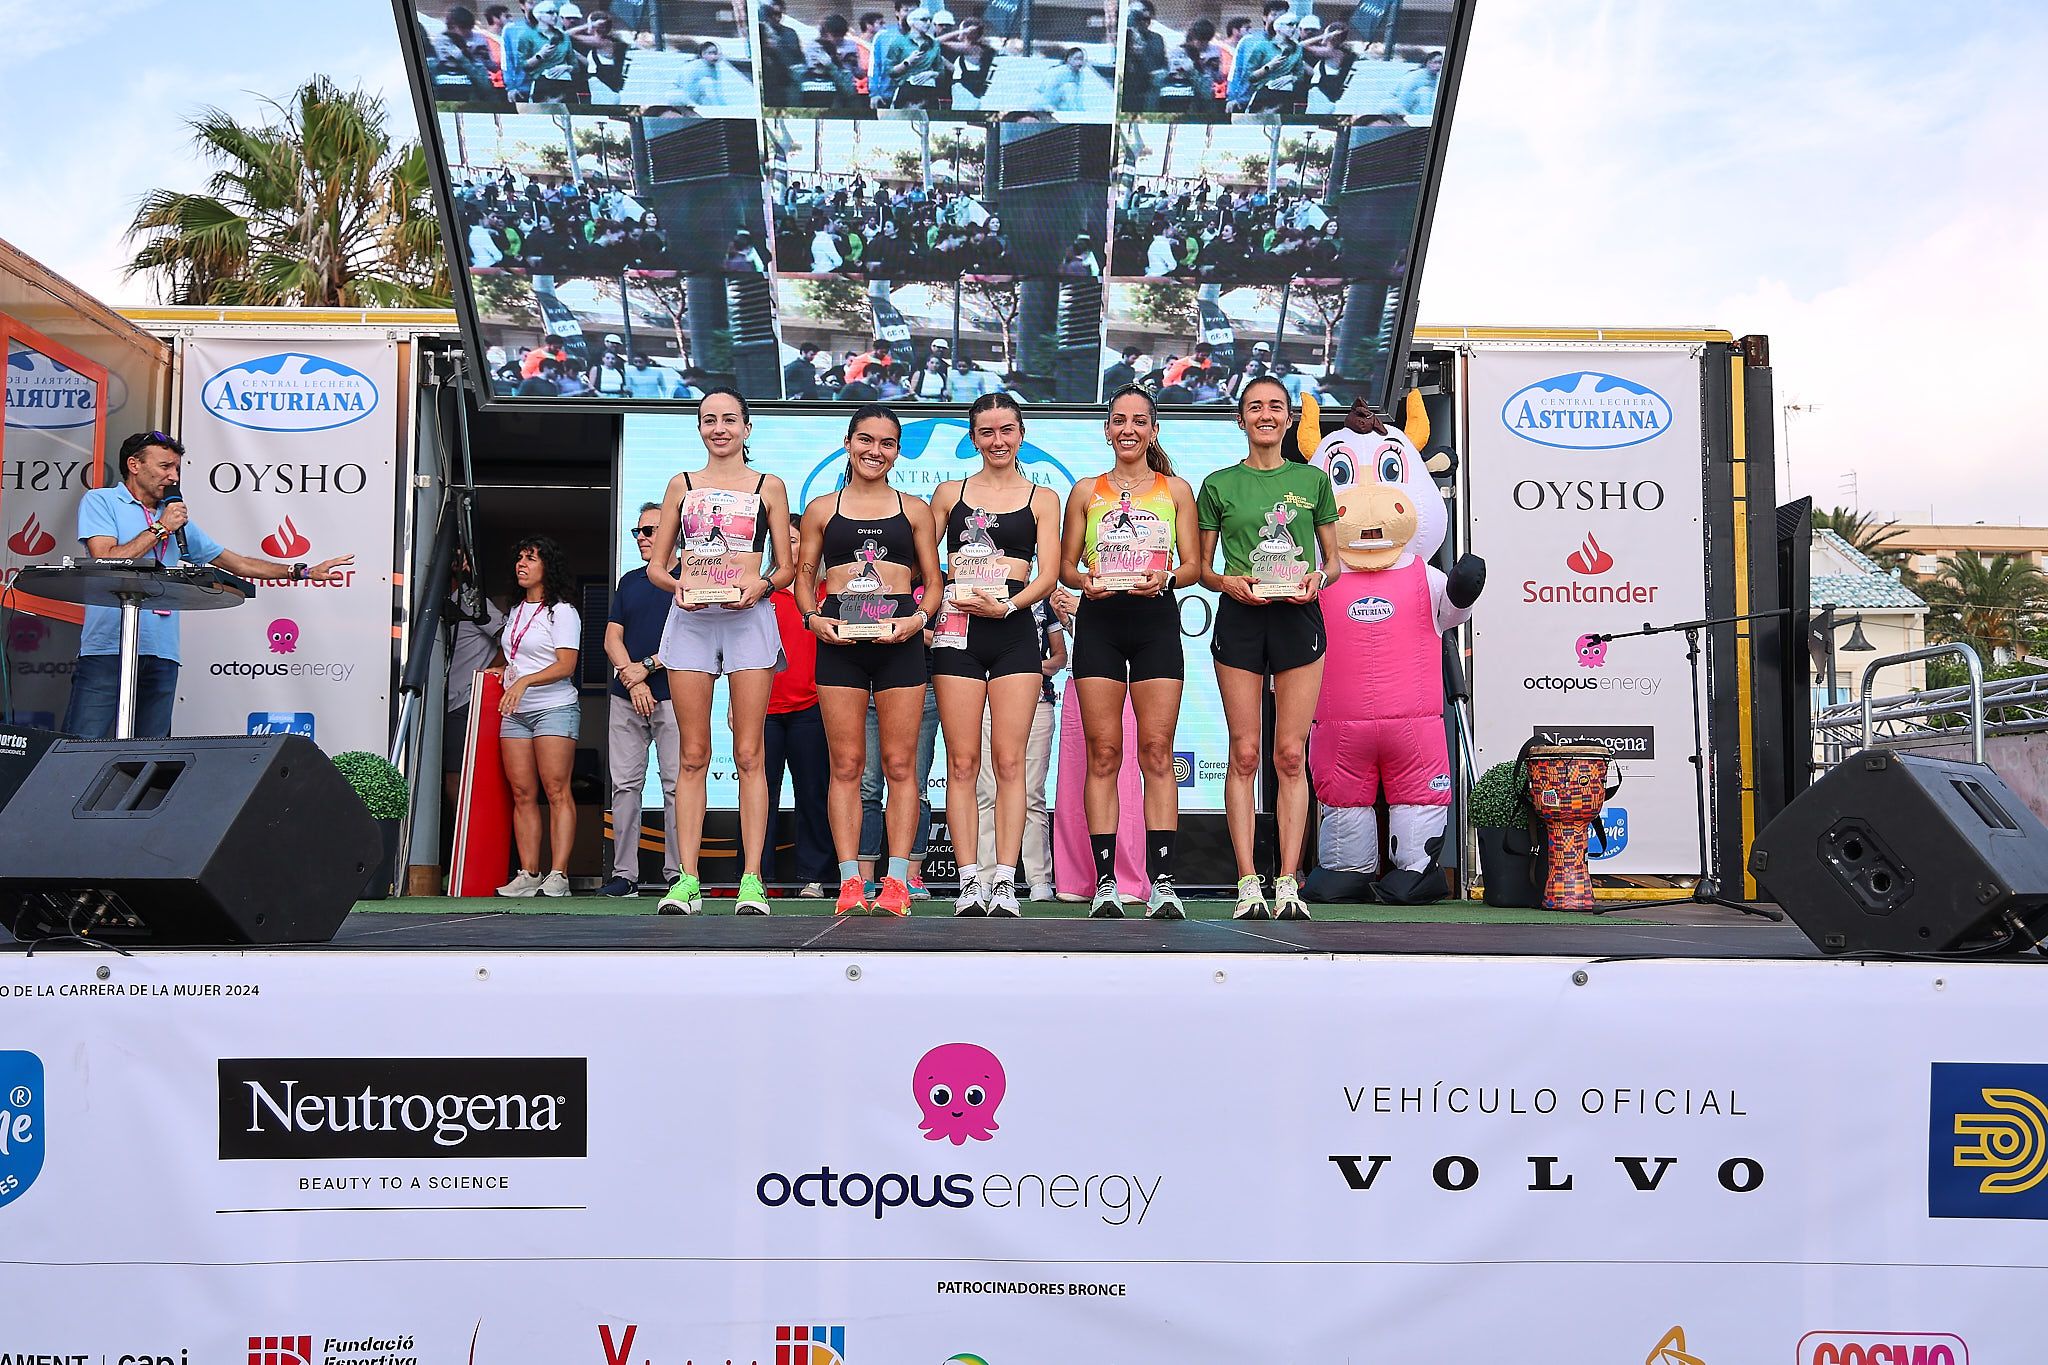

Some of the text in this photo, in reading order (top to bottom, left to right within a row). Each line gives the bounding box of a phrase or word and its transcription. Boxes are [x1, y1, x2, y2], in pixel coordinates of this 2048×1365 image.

[214, 381, 365, 411] ASTURIANA
[1541, 398, 1594, 406] CENTRAL
[1515, 400, 1660, 429] ASTURIANA
[209, 462, 367, 494] OYSHO
[1513, 480, 1664, 511] OYSHO
[1096, 542, 1130, 553] Carrera
[1253, 552, 1286, 562] Carrera
[686, 556, 722, 566] Carrera
[954, 556, 988, 566] Carrera
[1100, 553, 1108, 562] de
[1115, 551, 1149, 571] Mujer
[691, 567, 700, 576] de
[707, 565, 742, 585] Mujer
[959, 568, 967, 576] de
[975, 564, 1008, 582] Mujer
[1256, 562, 1265, 571] de
[1272, 561, 1306, 581] Mujer
[841, 592, 875, 601] Carrera
[1522, 580, 1658, 603] Santander
[844, 603, 852, 612] de
[860, 600, 894, 620] Mujer
[1350, 607, 1391, 616] ASTURIANA
[210, 661, 355, 681] octopus energy
[1523, 676, 1661, 695] octopus energy
[1199, 770, 1226, 780] Expres
[14, 985, 33, 997] DE
[37, 985, 55, 997] LA
[59, 984, 126, 997] CARRERA
[129, 984, 148, 996] DE
[152, 984, 169, 996] LA
[173, 984, 221, 996] MUJER
[225, 984, 260, 996] 2024
[1344, 1080, 1747, 1115] VEHÍCULO OFICIAL
[243, 1080, 562, 1146] Neutrogena
[299, 1176, 509, 1190] BEAUTY TO A SCIENCE
[1329, 1155, 1765, 1193] VOLVO
[757, 1165, 1162, 1226] octopus energy
[937, 1281, 1126, 1297] PATROCINADORES BRONCE
[323, 1334, 414, 1353] Fundació
